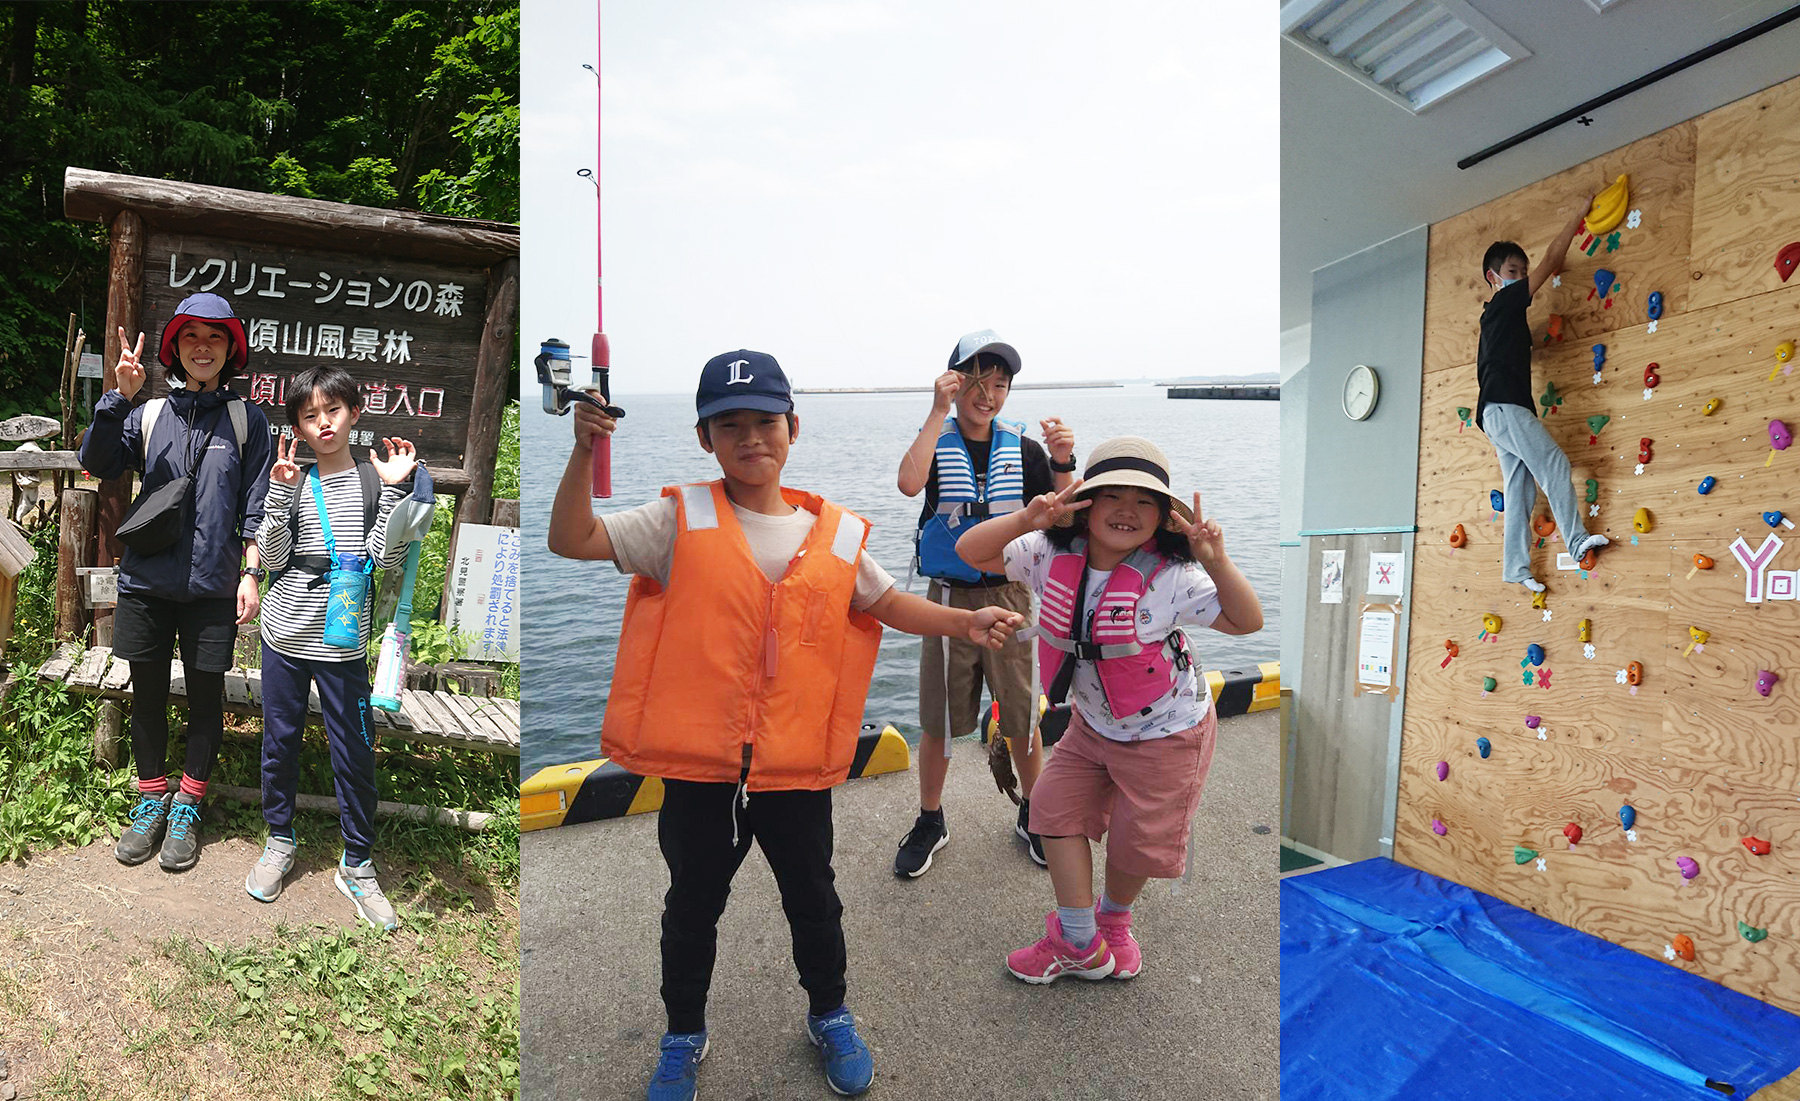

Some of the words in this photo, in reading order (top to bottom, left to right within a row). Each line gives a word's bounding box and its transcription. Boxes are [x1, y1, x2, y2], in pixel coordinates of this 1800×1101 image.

[169, 253, 465, 318] レクリエーションの森
[241, 318, 414, 365] 頃山風景林
[726, 359, 755, 385] L
